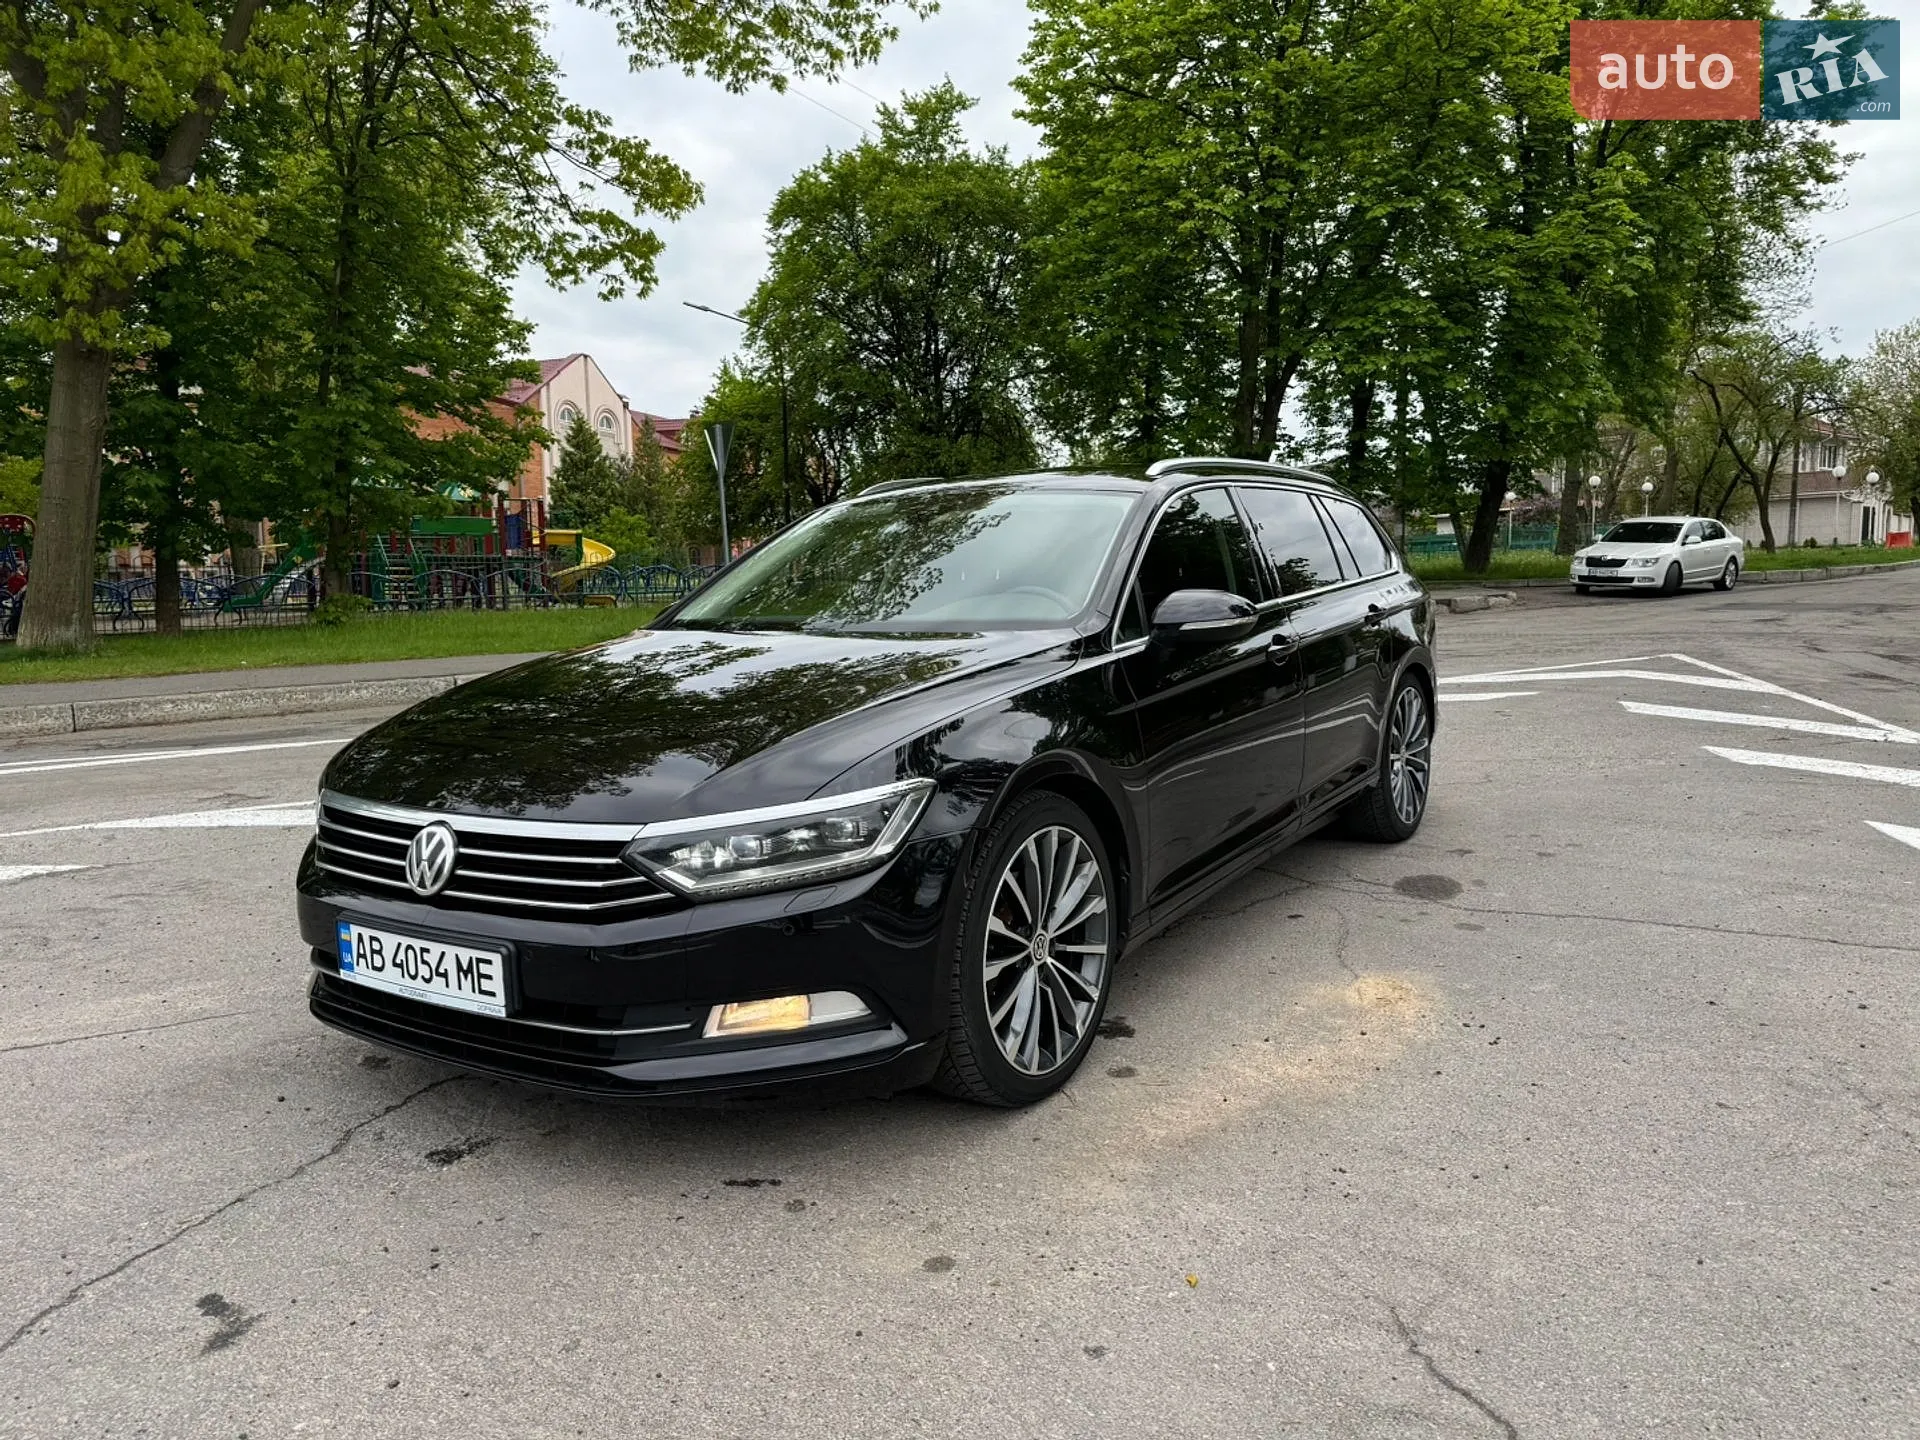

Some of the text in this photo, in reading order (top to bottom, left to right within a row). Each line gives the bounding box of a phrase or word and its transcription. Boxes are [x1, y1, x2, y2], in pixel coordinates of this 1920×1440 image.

[356, 932, 496, 997] AB 4054 ME
